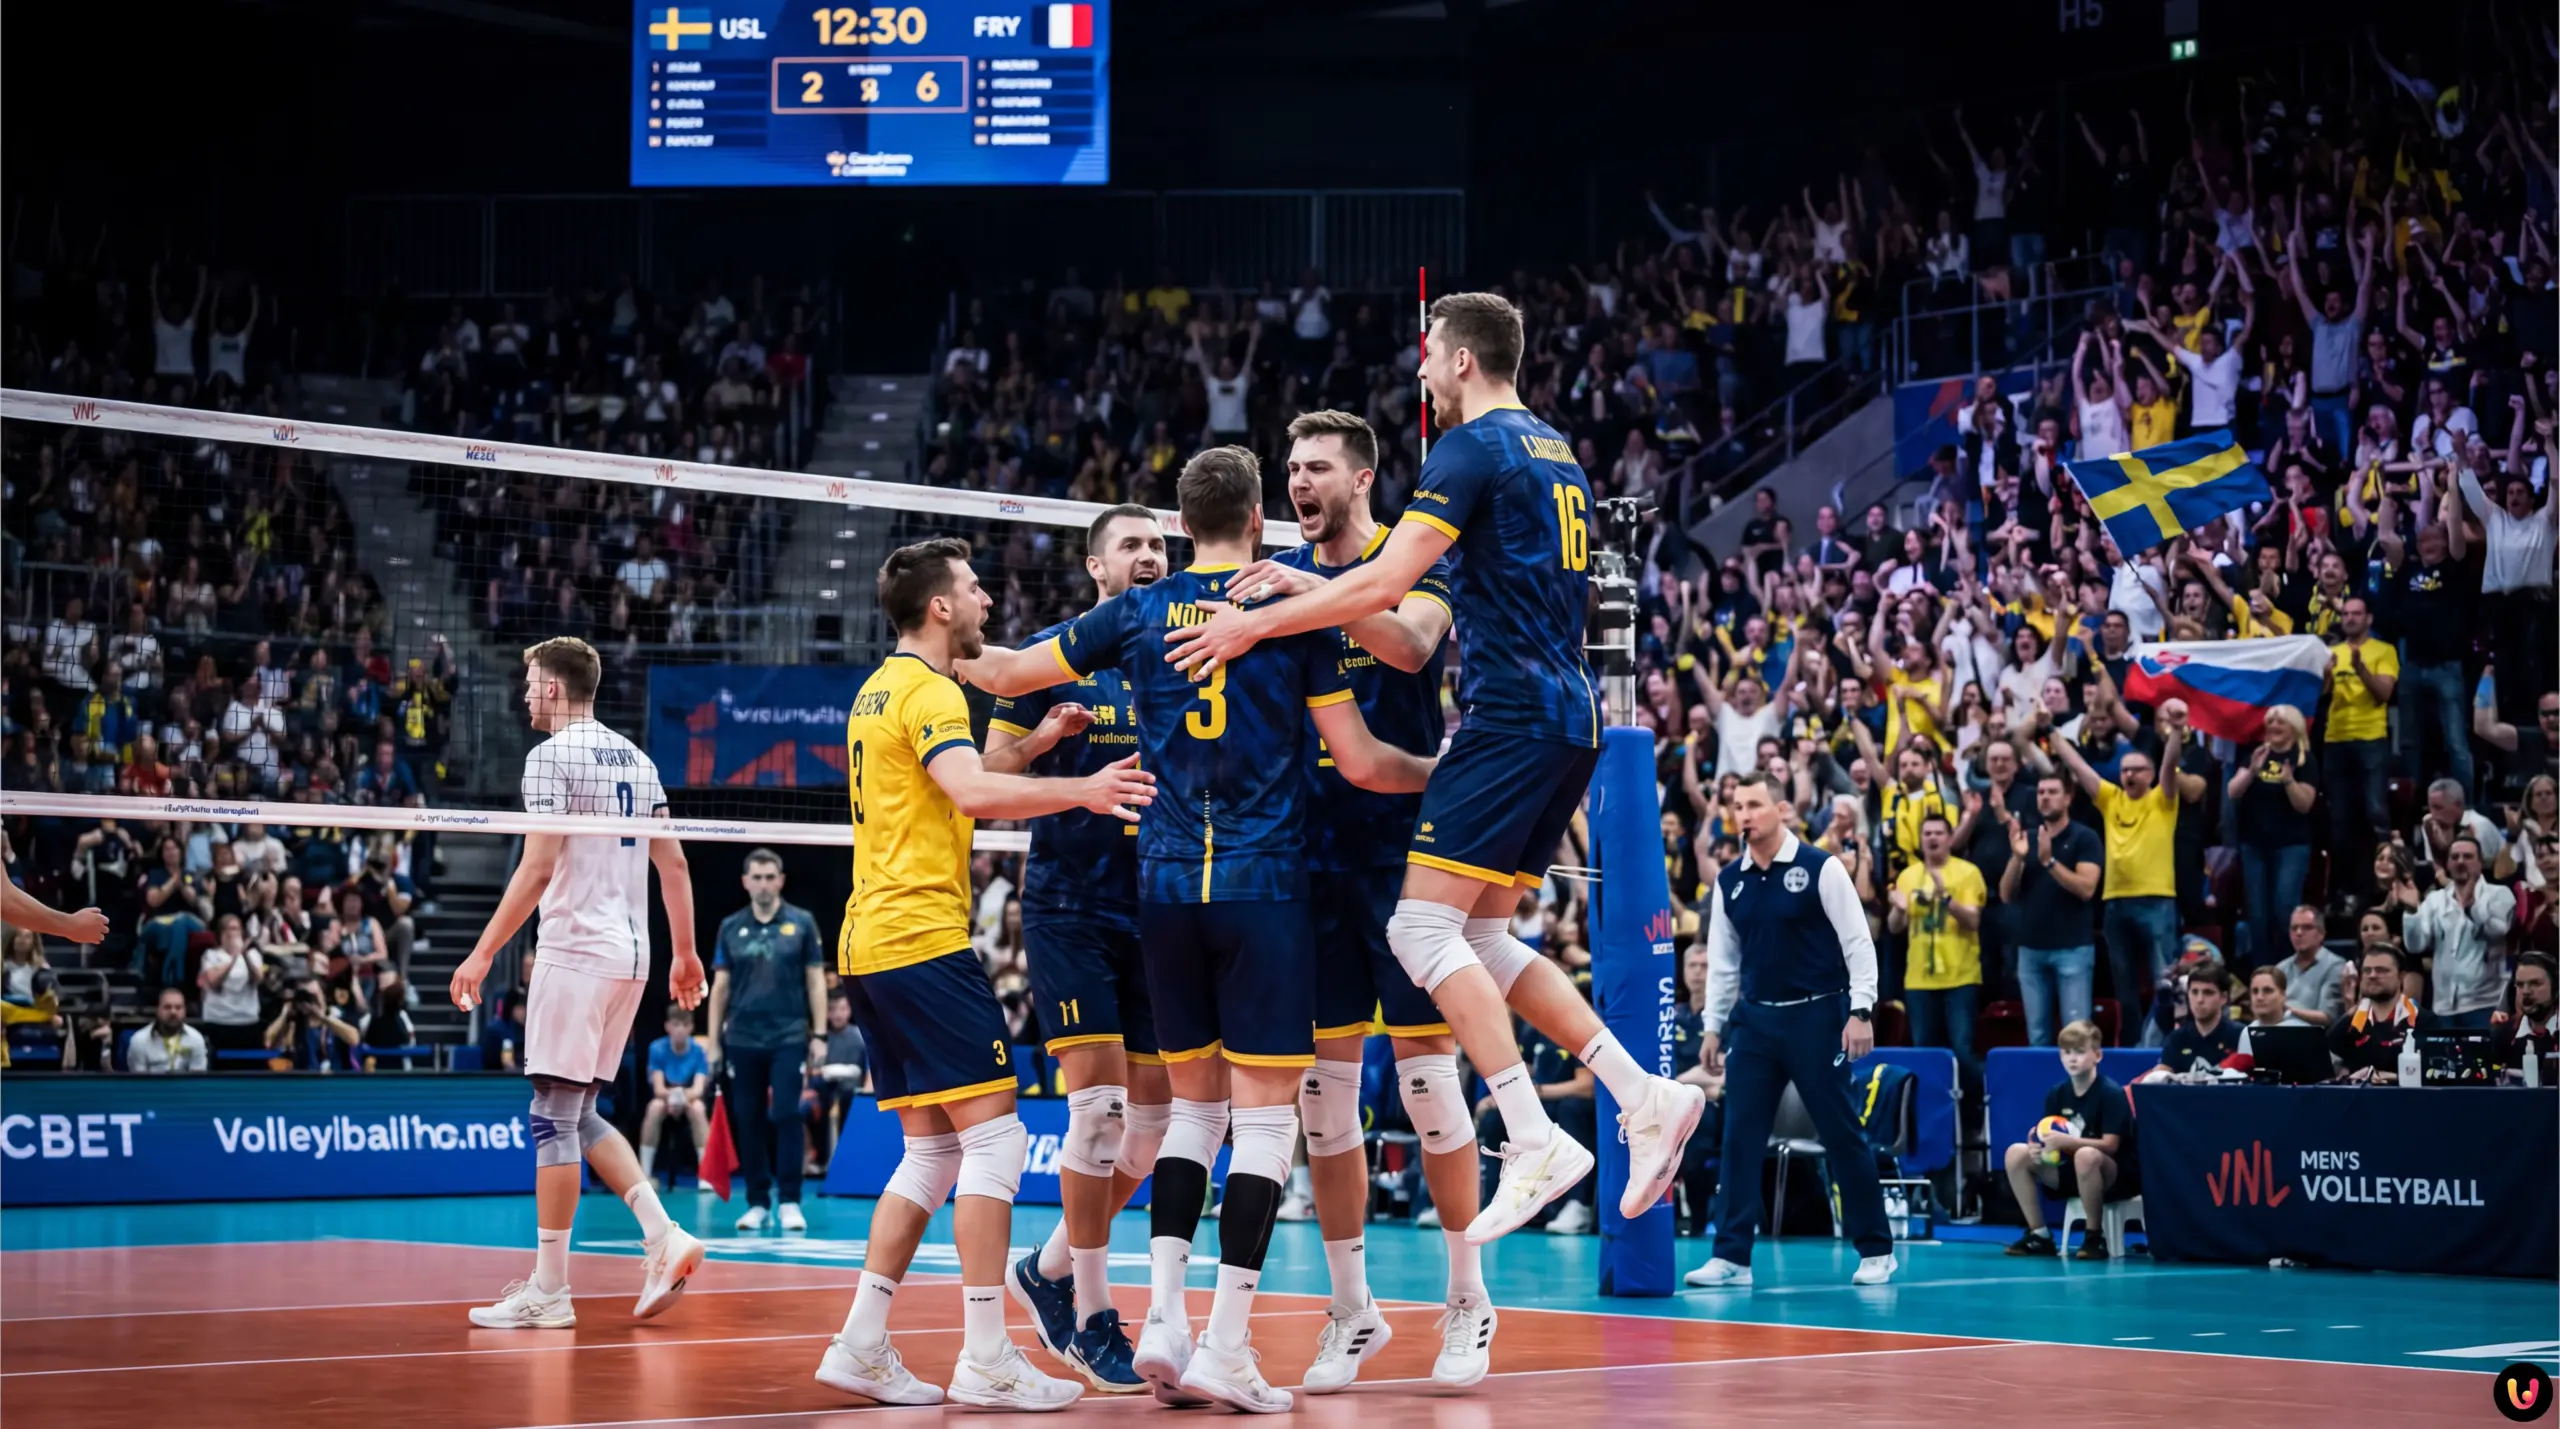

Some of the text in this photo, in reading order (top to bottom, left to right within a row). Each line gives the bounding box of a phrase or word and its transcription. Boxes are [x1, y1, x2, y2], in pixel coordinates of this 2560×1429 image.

[719, 17, 767, 39] USL
[812, 7, 927, 45] 12:30
[973, 16, 1021, 38] FRY
[801, 71, 824, 103] 2
[916, 71, 940, 102] 6
[73, 401, 101, 421] VNL
[1553, 483, 1588, 572] 16
[1185, 660, 1227, 740] 3
[853, 740, 865, 825] 3
[1059, 998, 1080, 1026] 11
[993, 1040, 1007, 1066] 3
[0, 1113, 142, 1159] CBET
[2206, 1140, 2290, 1207] VNL
[2300, 1150, 2360, 1170] MEN'S
[2301, 1174, 2485, 1207] VOLLEYBALL
